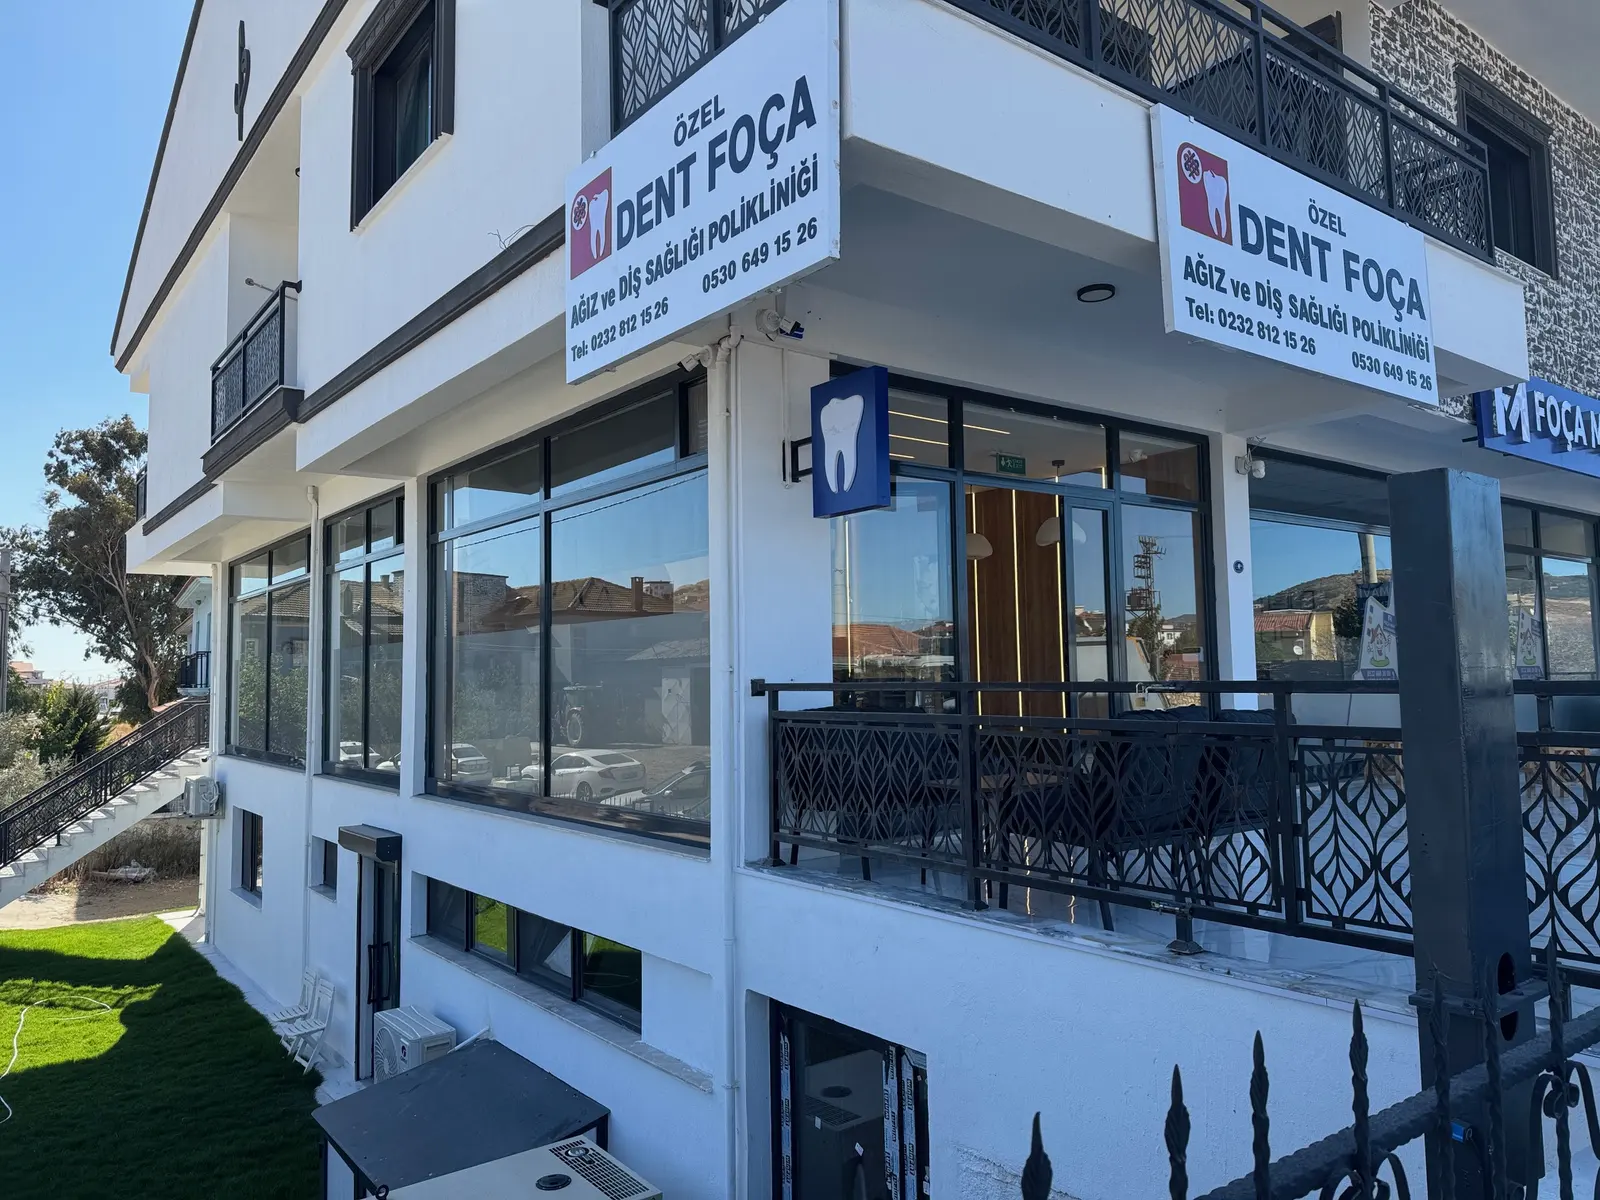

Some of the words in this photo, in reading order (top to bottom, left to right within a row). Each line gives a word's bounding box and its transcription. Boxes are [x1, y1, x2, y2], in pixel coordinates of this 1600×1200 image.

[616, 152, 697, 251] DENT
[707, 75, 816, 192] FOÇA
[673, 94, 725, 147] ÖZEL
[570, 291, 598, 329] AĞIZ
[601, 288, 616, 307] ve
[618, 264, 641, 299] DİŞ
[645, 228, 705, 285] SAĞLIĞI
[708, 152, 819, 251] POLİKLİNİĞİ
[1238, 204, 1332, 283] DENT
[1342, 248, 1427, 322] FOÇA
[1308, 198, 1347, 237] ÖZEL
[570, 340, 588, 362] Tel:
[590, 324, 617, 351] 0232
[619, 313, 637, 340] 812
[640, 307, 652, 328] 15
[654, 296, 669, 320] 26
[702, 262, 737, 293] 0530
[741, 244, 769, 273] 649
[774, 230, 791, 256] 15
[796, 217, 818, 247] 26
[1183, 252, 1228, 294] AĞIZ
[1230, 278, 1251, 301] ve
[1255, 279, 1283, 318] DİŞ
[1288, 294, 1348, 335] SAĞLIĞI
[1352, 315, 1431, 363] POLİKLİNİĞİ
[1185, 296, 1215, 324] Tel:
[1218, 308, 1254, 337] 0232
[1257, 321, 1280, 345] 812
[1283, 331, 1298, 350] 15
[1300, 336, 1316, 355] 26
[1351, 351, 1381, 375] 0530
[1383, 360, 1404, 382] 649
[1405, 369, 1418, 387] 15
[1420, 374, 1432, 391] 26
[1533, 390, 1588, 452] FOÇA
